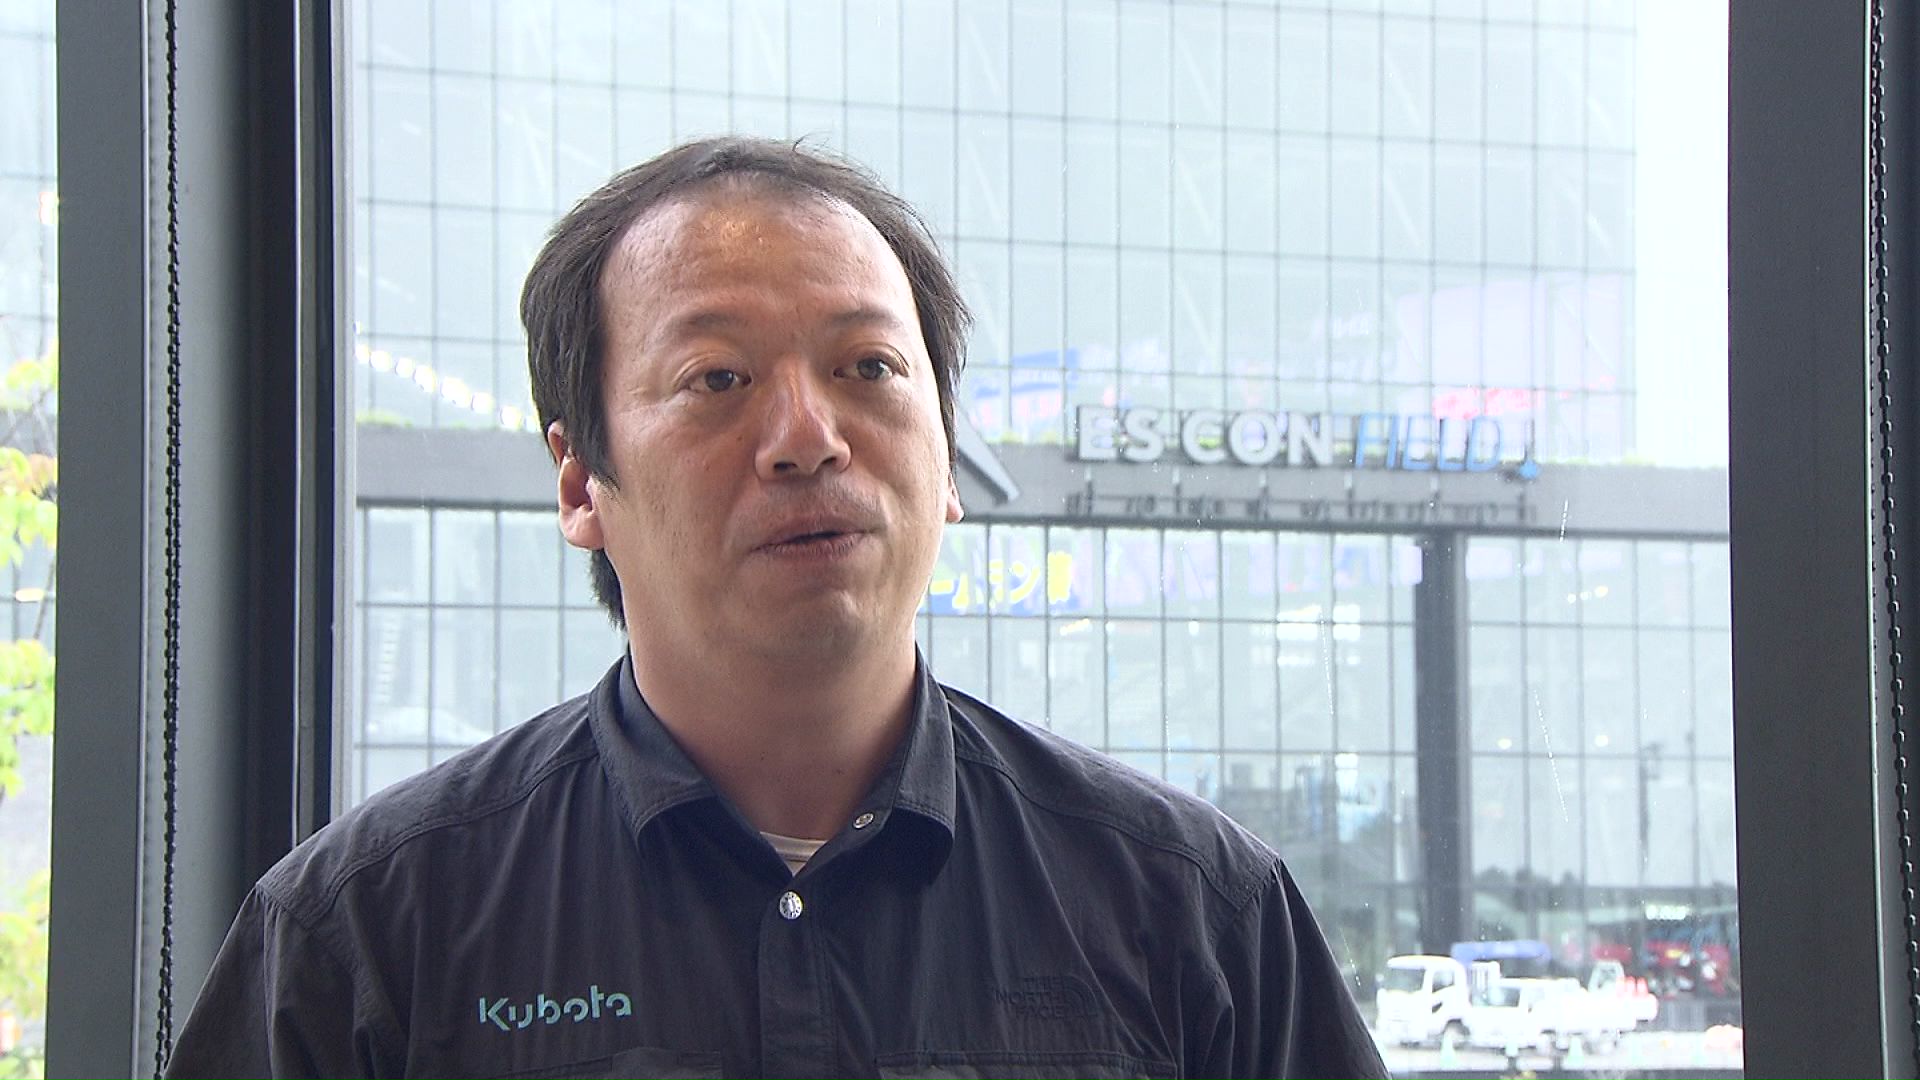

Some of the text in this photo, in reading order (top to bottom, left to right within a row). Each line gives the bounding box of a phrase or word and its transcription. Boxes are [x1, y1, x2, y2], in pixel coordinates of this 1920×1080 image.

[1077, 404, 1166, 464] ES
[1180, 408, 1335, 467] CON
[1354, 411, 1506, 472] FIELD
[1023, 975, 1062, 989] THE
[993, 988, 1065, 1005] NORTH
[479, 984, 632, 1031] Kubota
[1016, 1004, 1065, 1020] FACE
